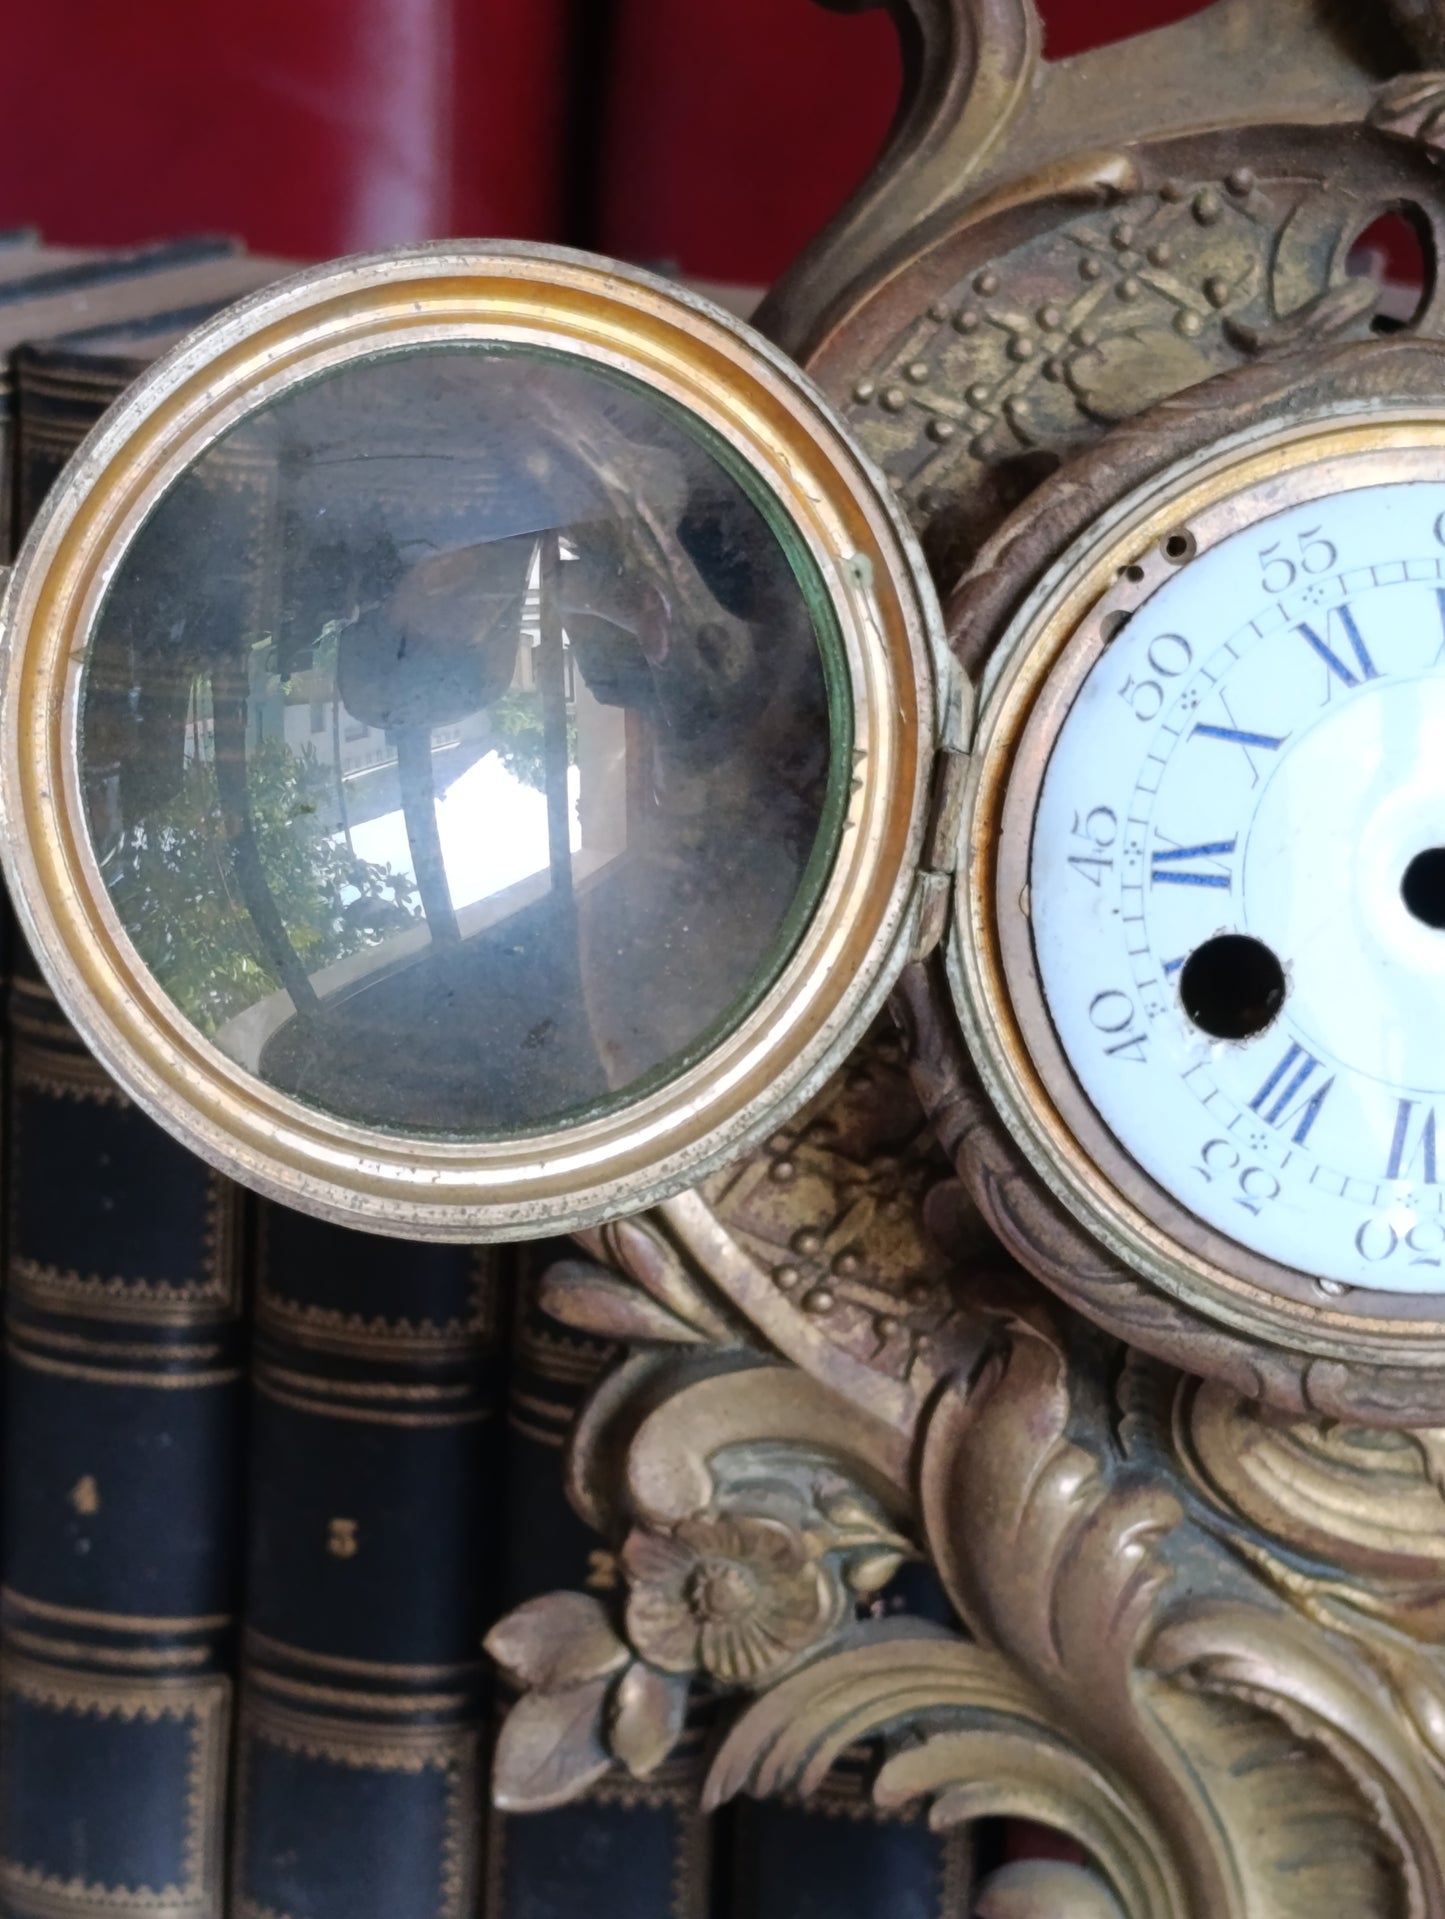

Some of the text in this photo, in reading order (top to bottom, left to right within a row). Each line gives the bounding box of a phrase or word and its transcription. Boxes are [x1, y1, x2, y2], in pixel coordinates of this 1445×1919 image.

[1258, 525, 1338, 594] 55
[1117, 632, 1193, 722] 50
[1288, 601, 1388, 707] XI
[1186, 686, 1293, 789] X
[1067, 805, 1118, 888] 45
[1150, 826, 1239, 898] IX
[1089, 989, 1148, 1064] 40
[1248, 1034, 1337, 1151] VII
[1191, 1138, 1281, 1217] 35
[587, 1551, 615, 1588] 2
